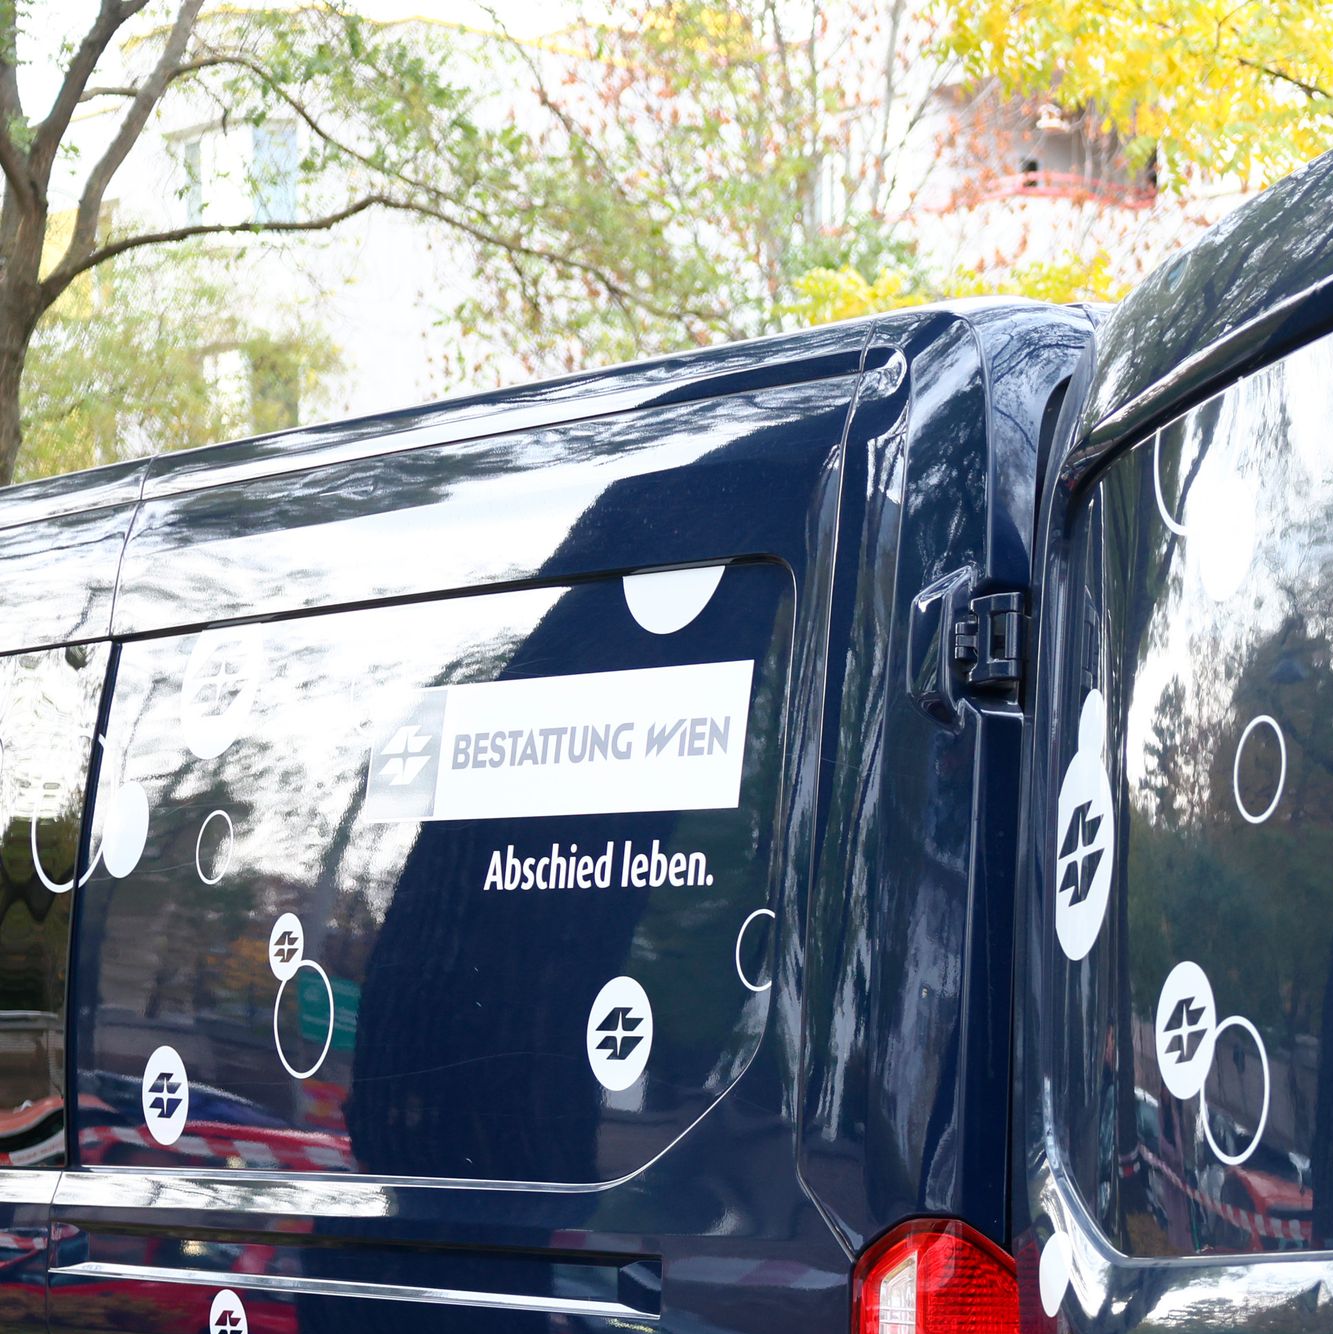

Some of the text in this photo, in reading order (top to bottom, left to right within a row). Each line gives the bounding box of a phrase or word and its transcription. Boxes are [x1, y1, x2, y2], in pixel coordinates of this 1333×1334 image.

[451, 715, 731, 770] BESTATTUNG WIEN
[483, 839, 714, 891] Abschied leben.
